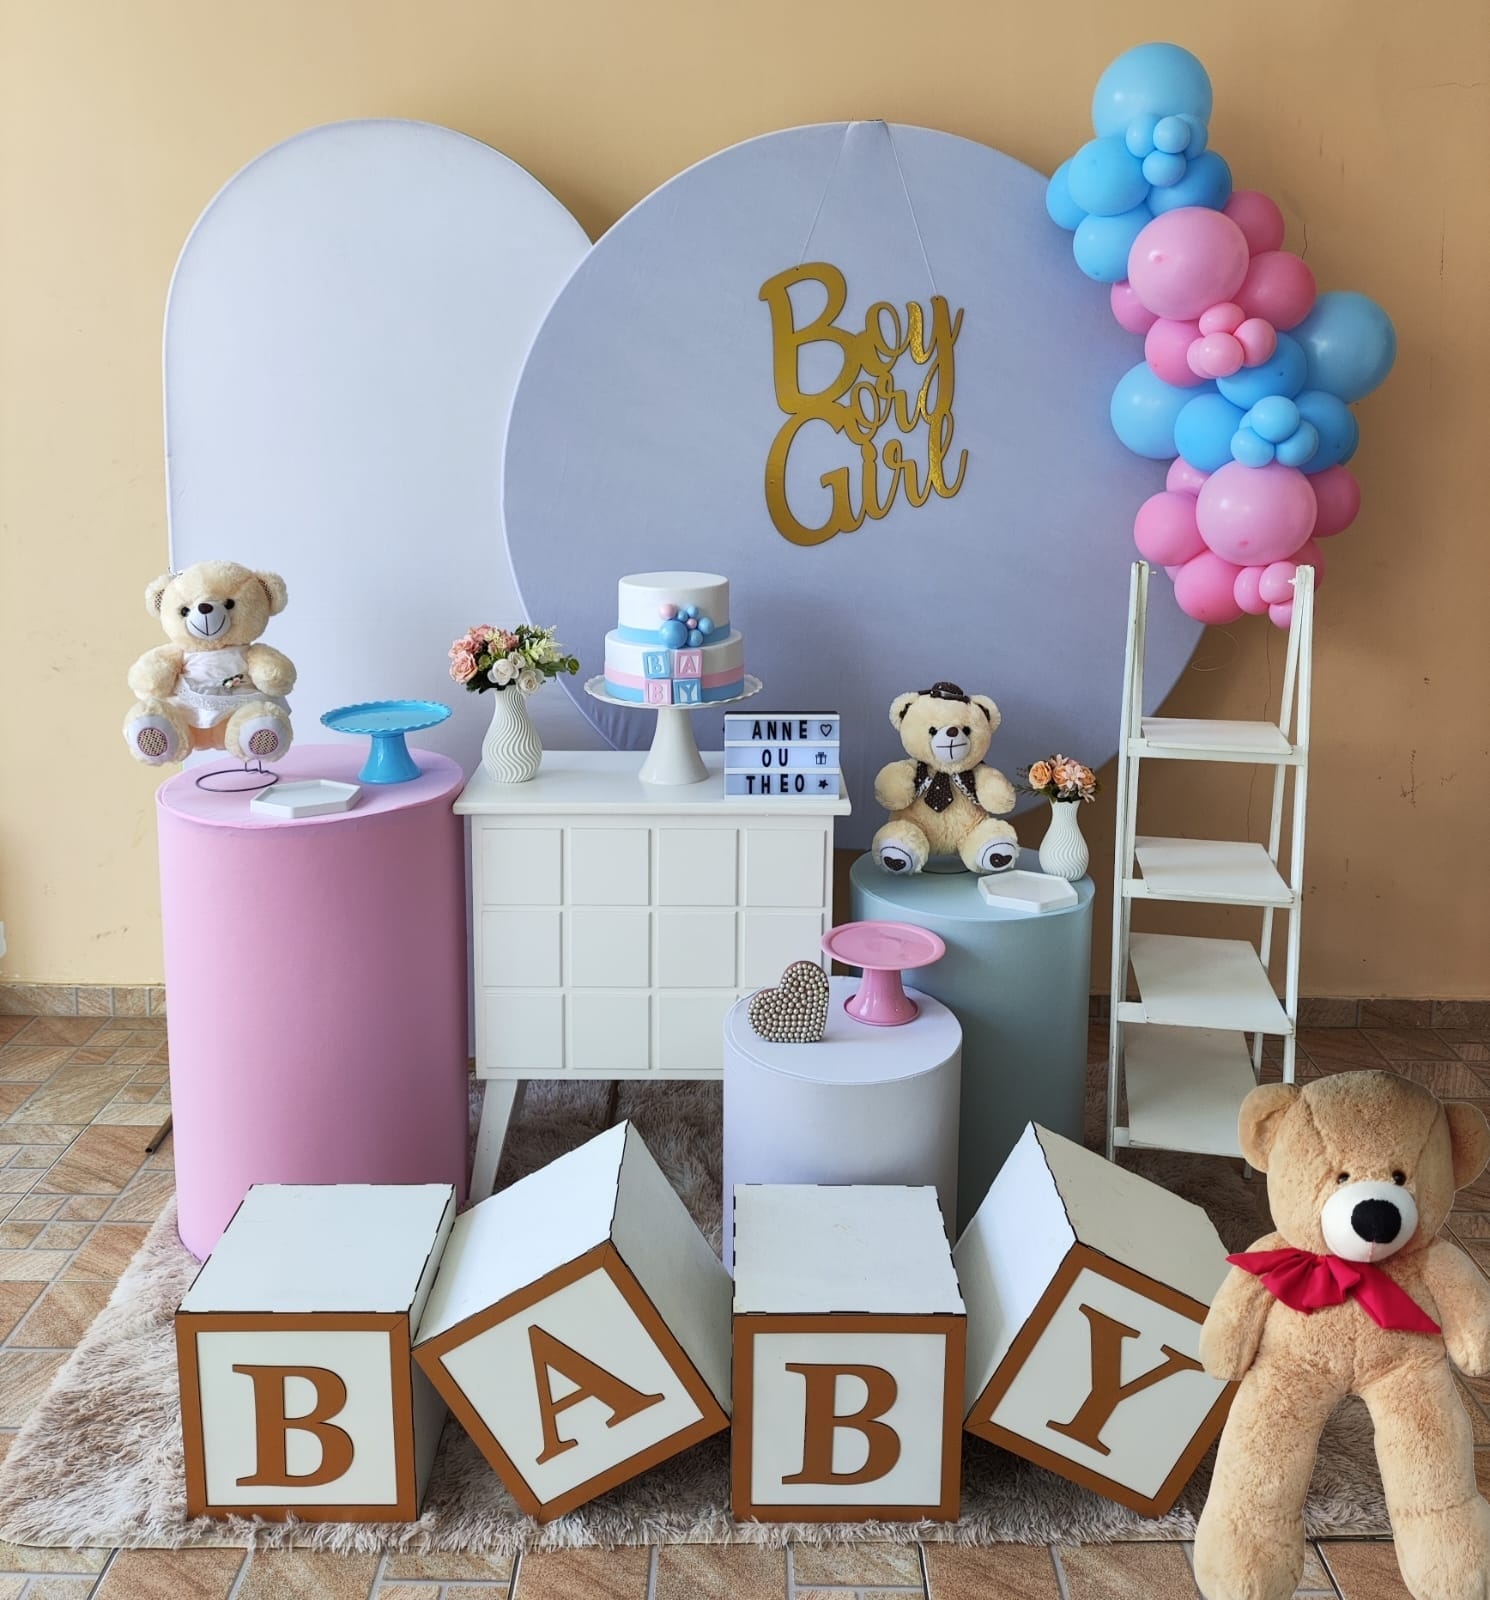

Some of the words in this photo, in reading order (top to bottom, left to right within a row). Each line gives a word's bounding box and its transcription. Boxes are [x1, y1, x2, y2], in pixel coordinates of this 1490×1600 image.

[759, 262, 964, 422] Boy
[846, 372, 924, 445] or
[765, 402, 968, 546] Girl
[752, 720, 808, 741] ANNE
[762, 749, 788, 767] OU
[746, 774, 805, 795] THEO
